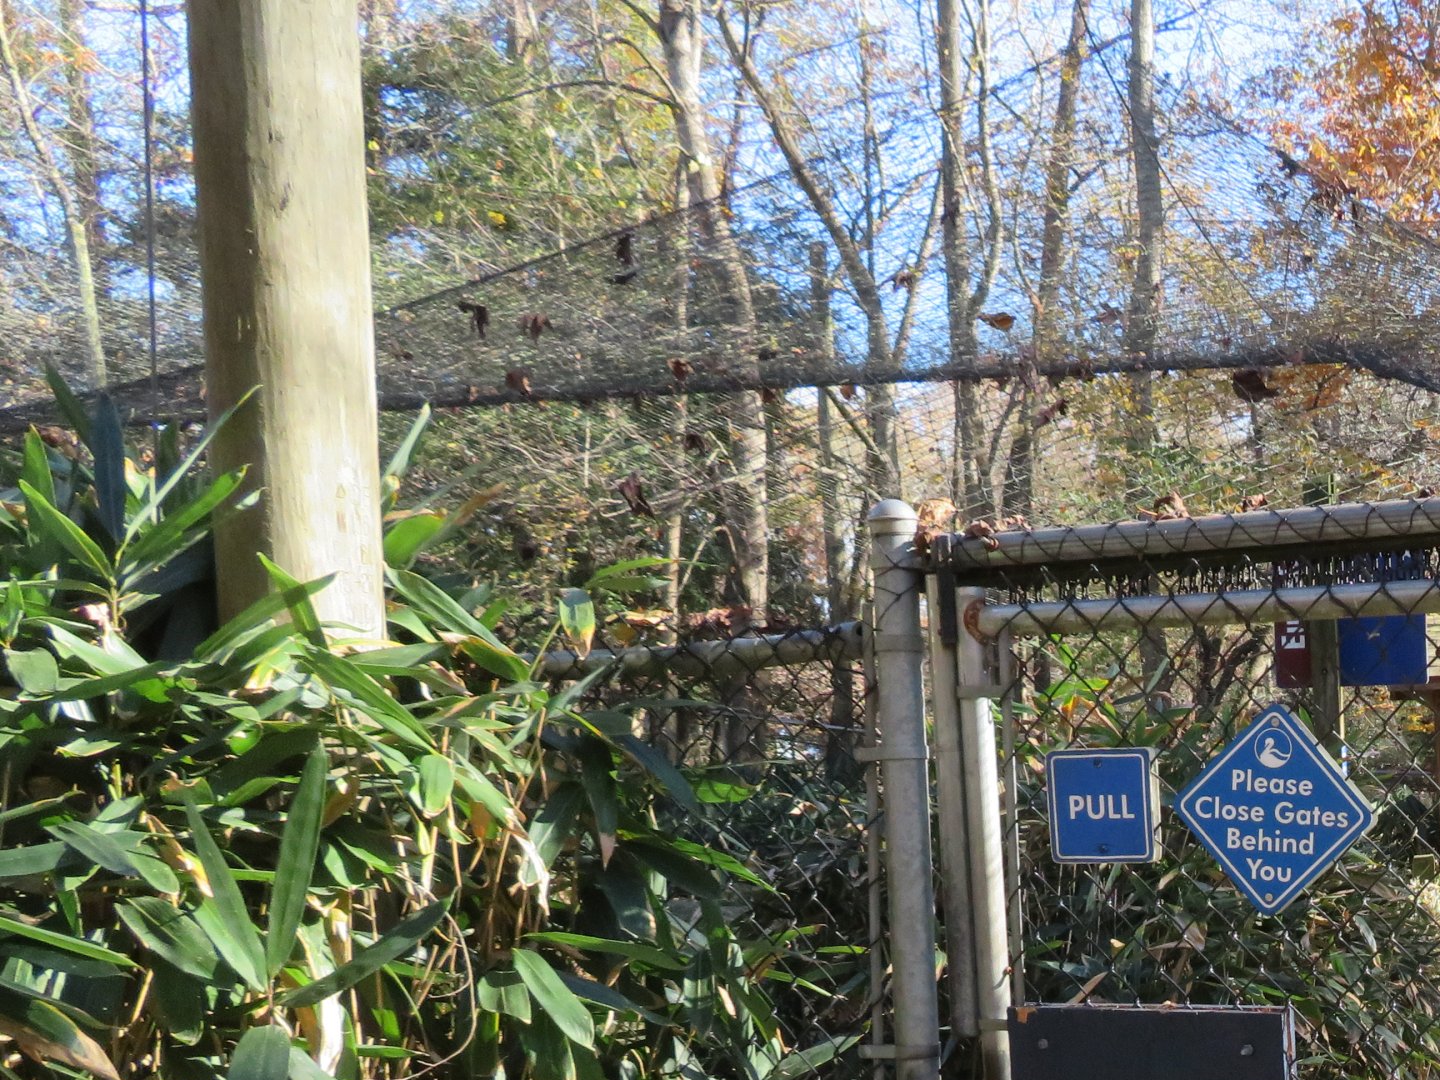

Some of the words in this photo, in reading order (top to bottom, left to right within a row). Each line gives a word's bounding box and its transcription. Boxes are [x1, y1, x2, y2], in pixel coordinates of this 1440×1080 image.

[1231, 768, 1313, 796] Please
[1068, 794, 1136, 820] PULL
[1194, 796, 1265, 822] Close
[1274, 801, 1349, 828] Gates
[1226, 827, 1315, 855] Behind
[1245, 857, 1292, 882] You
